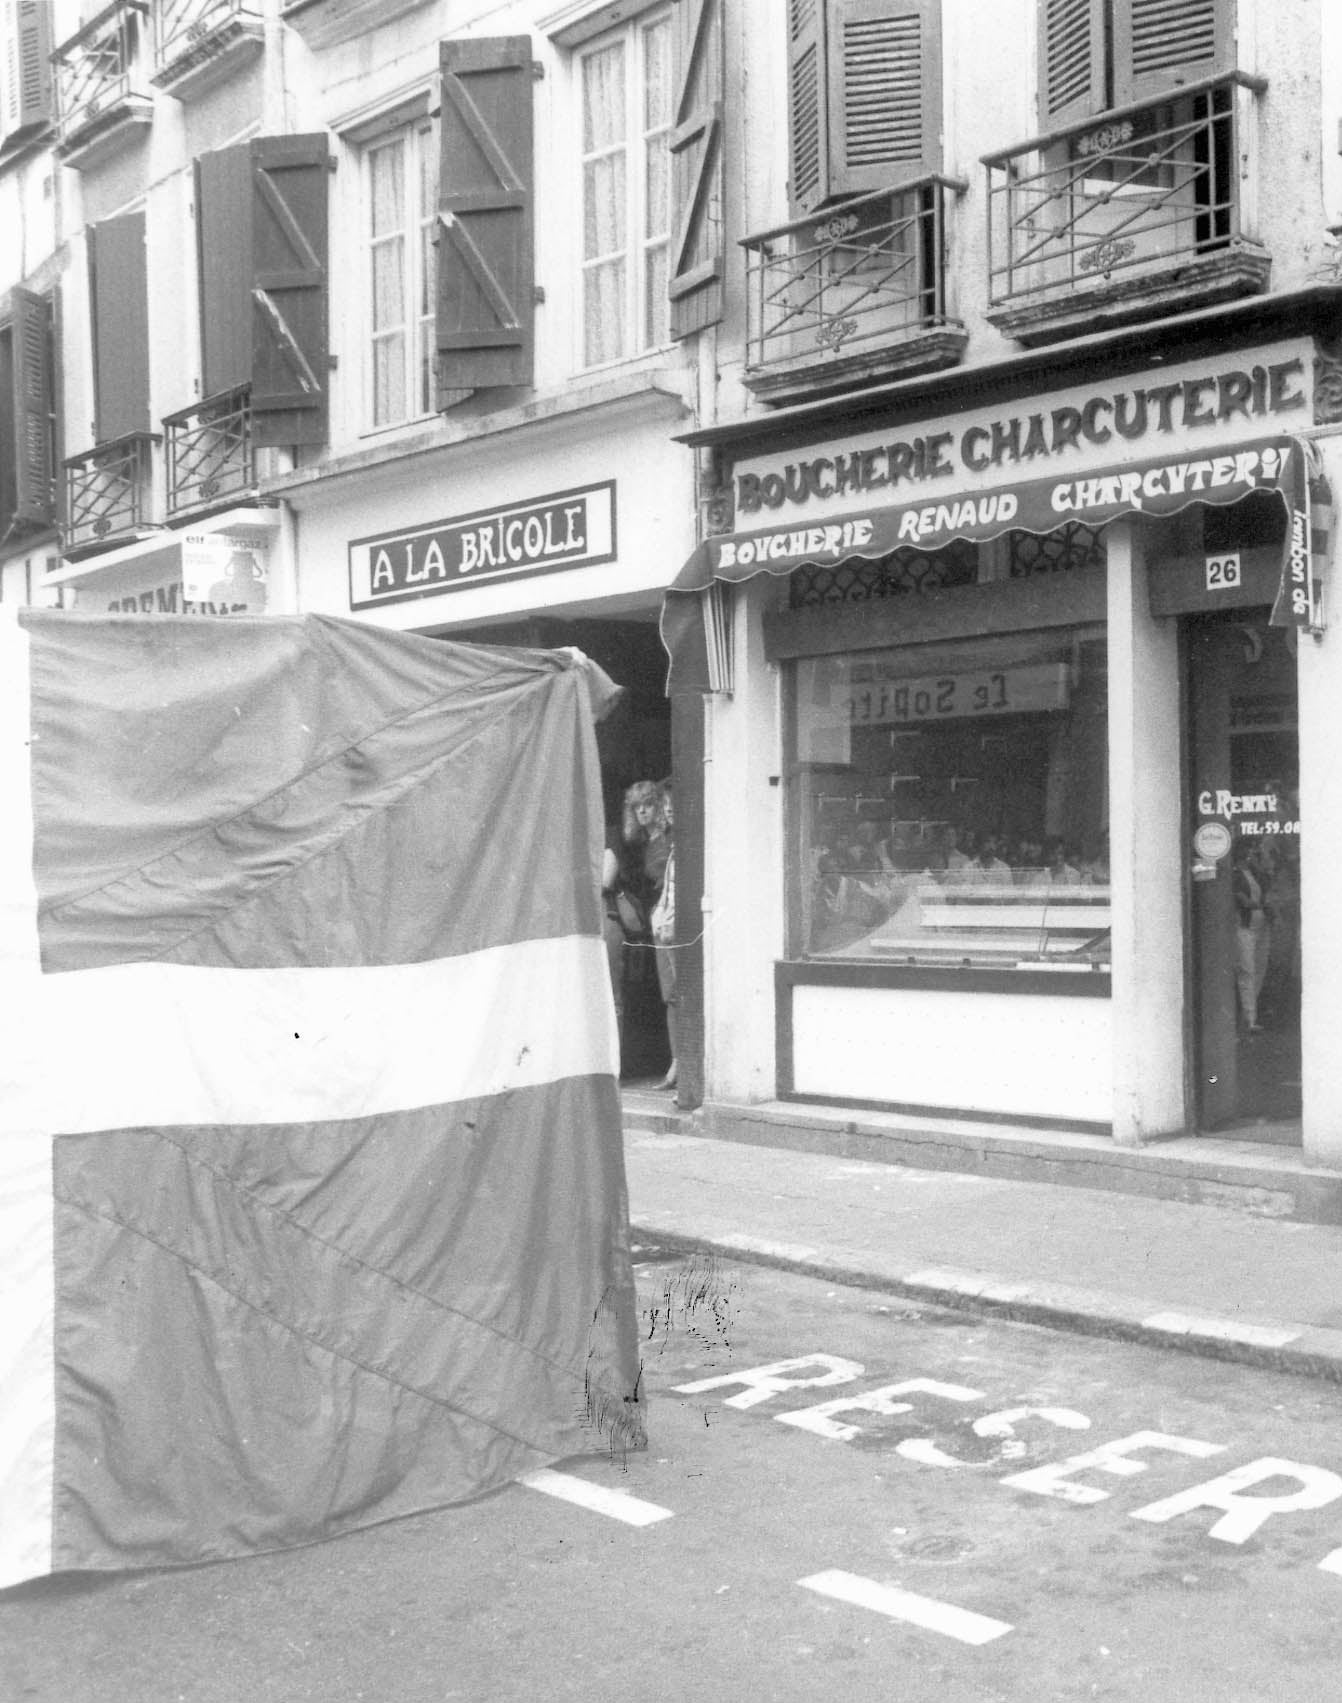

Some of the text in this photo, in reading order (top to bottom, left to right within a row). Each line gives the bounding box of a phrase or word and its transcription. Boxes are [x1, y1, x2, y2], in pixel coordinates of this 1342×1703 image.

[737, 358, 1305, 512] BOUCHERIE CHARCUTERIE
[373, 505, 584, 588] A LA BRICOLE
[899, 491, 1017, 541] RENAUD
[1208, 558, 1239, 584] 26
